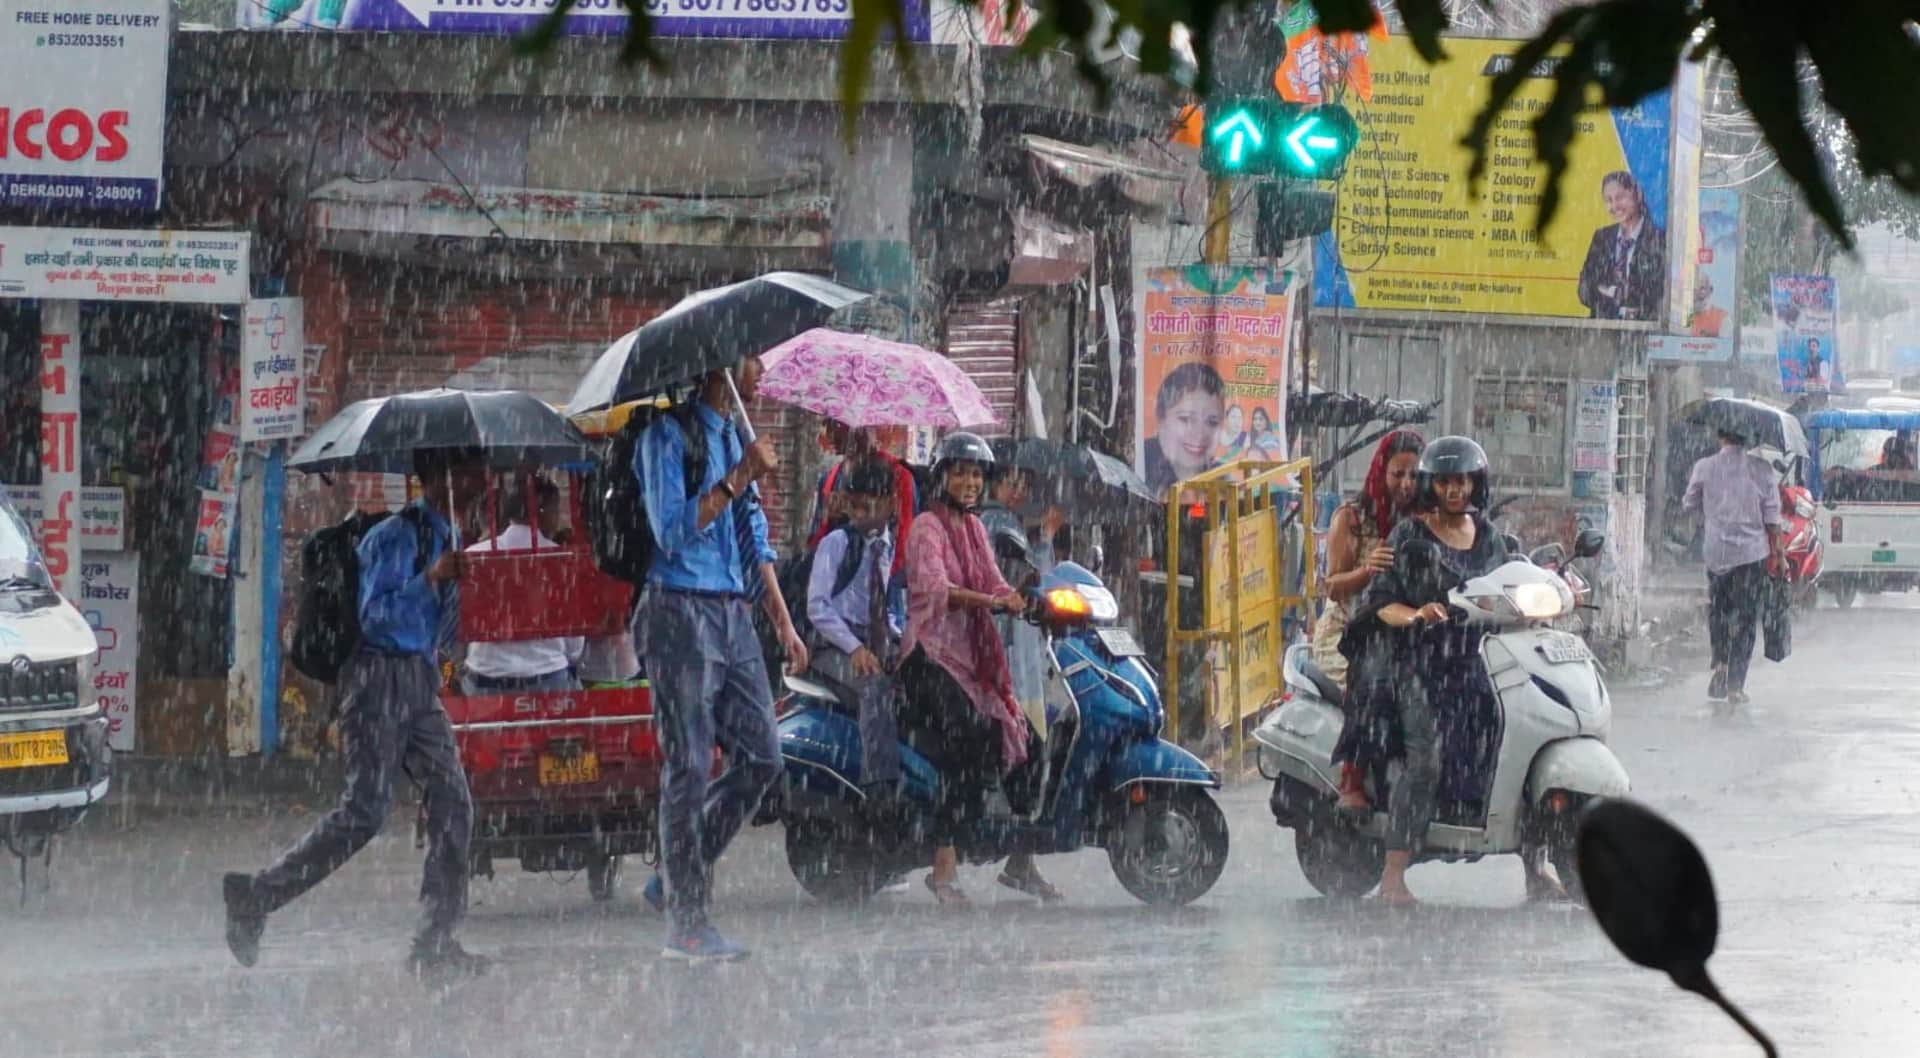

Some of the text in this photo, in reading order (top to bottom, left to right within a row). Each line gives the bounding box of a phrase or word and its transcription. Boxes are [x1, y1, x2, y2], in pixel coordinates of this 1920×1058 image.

[16, 12, 160, 27] FREE HOME DELIVERY
[48, 33, 125, 48] 8532033551
[1355, 110, 1416, 125] Agriculture
[1360, 130, 1400, 145] orestry
[1354, 148, 1418, 162] Horticulture
[1494, 154, 1531, 169] Botany
[1406, 169, 1450, 182] Science
[1493, 172, 1536, 189] Zoology
[10, 183, 84, 198] DEHRADUN
[96, 187, 143, 200] 248001
[1352, 185, 1443, 203] Food Technology
[1492, 209, 1514, 223] BBA
[1433, 227, 1475, 240] science
[1491, 228, 1517, 242] MBA
[72, 237, 96, 247] FREE
[97, 238, 123, 248] HOME
[126, 239, 169, 249] DELIVERY
[1394, 242, 1436, 257] Science
[1487, 248, 1505, 259] and
